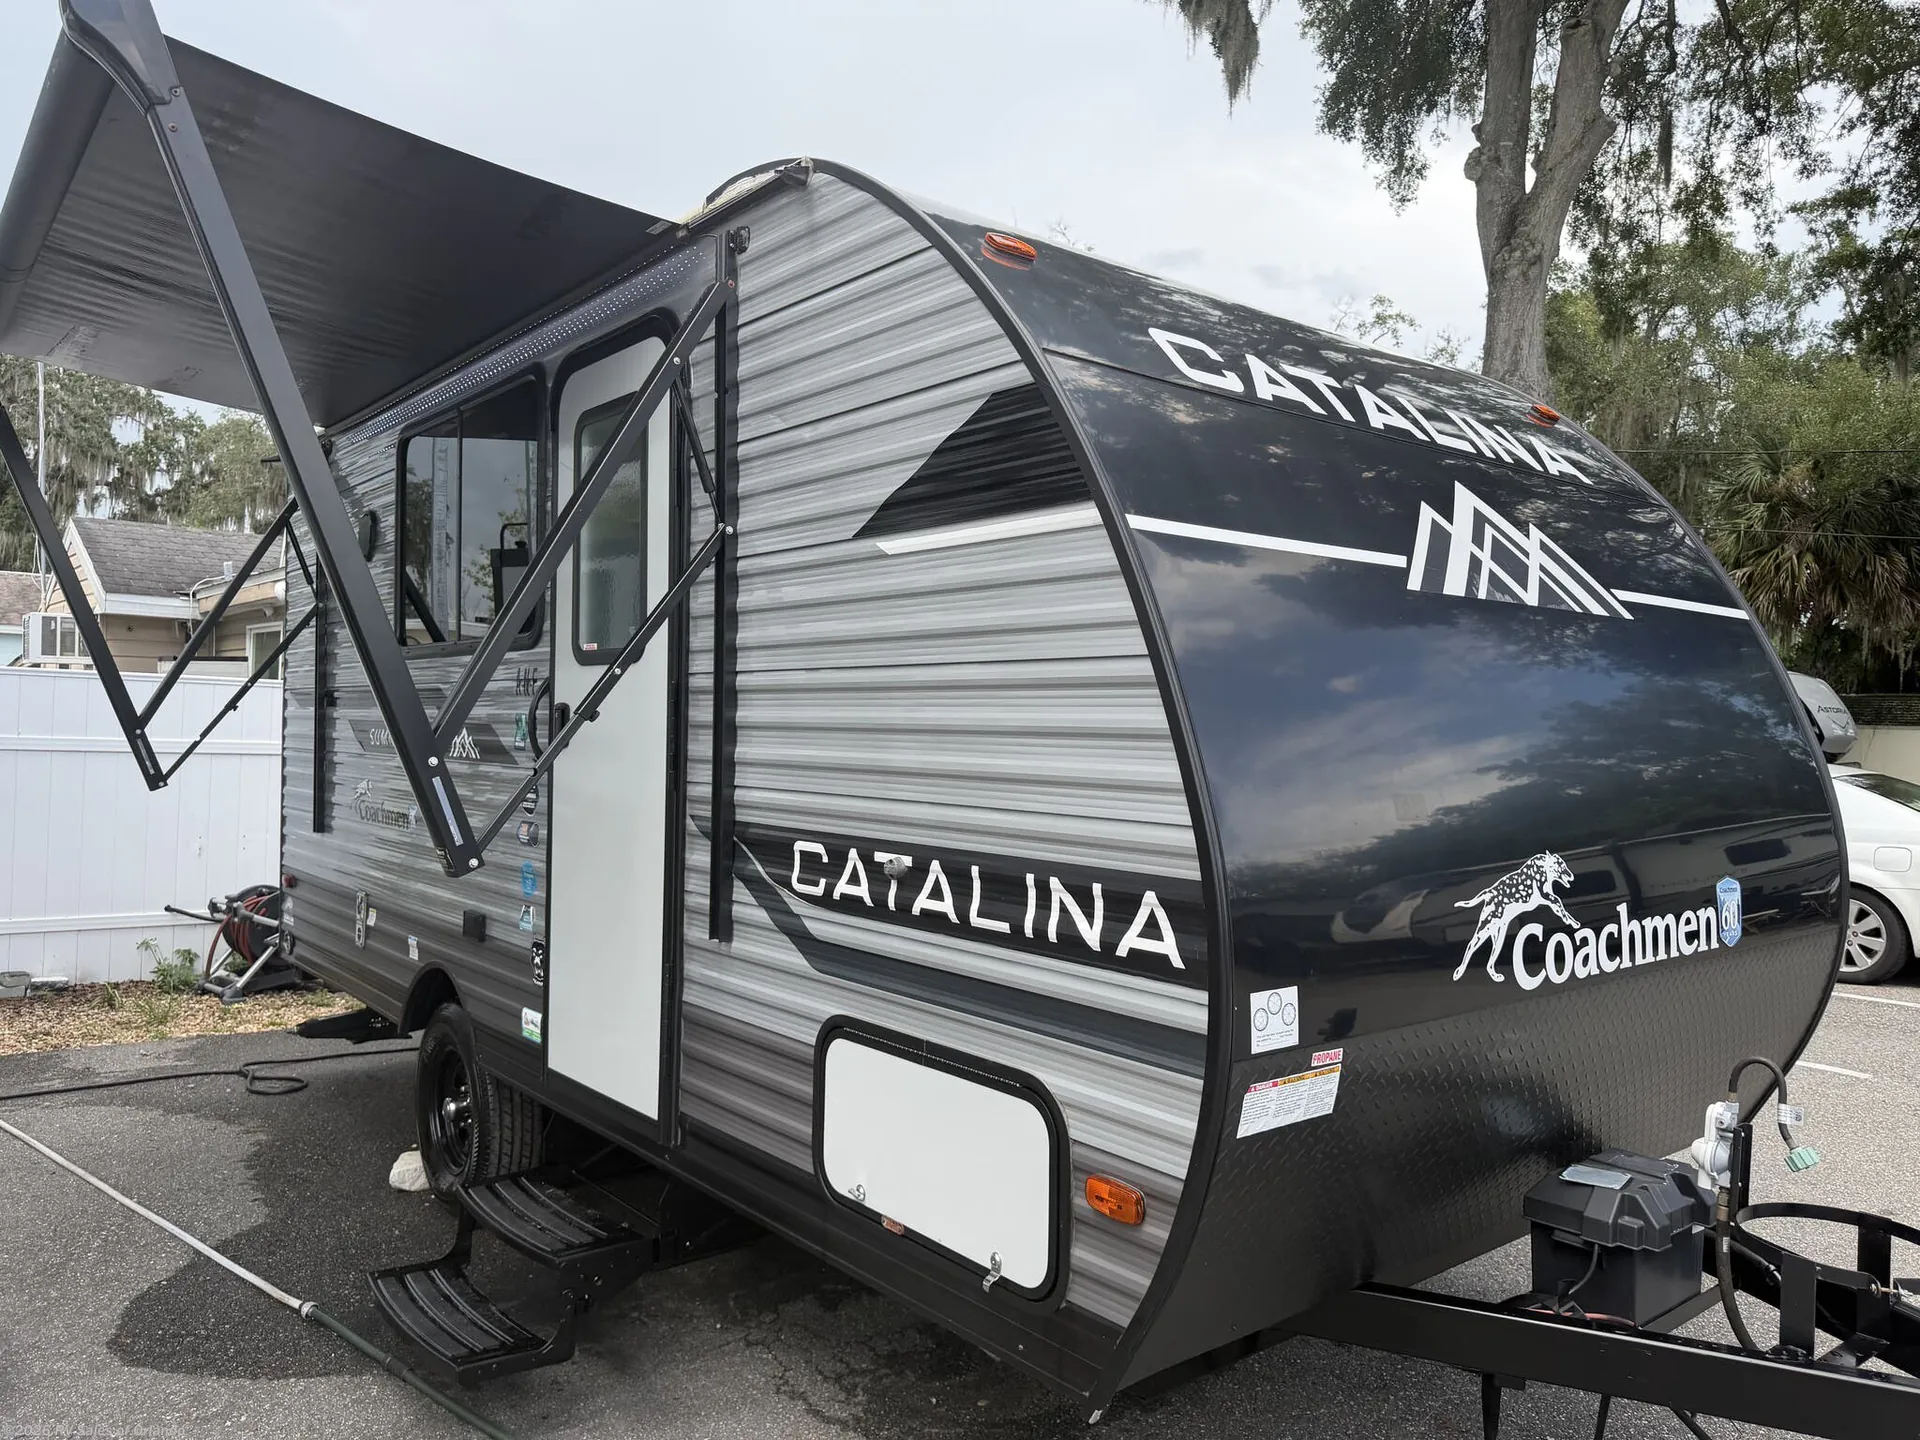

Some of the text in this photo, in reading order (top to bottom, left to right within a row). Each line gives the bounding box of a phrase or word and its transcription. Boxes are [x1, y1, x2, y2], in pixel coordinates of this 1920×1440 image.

[1148, 327, 1594, 486] CATALINA
[359, 800, 409, 831] Coachmen
[791, 840, 1186, 970] CATALINA
[1721, 900, 1738, 931] 60
[1512, 902, 1720, 991] Coachmen
[1313, 1050, 1341, 1064] PROPANE
